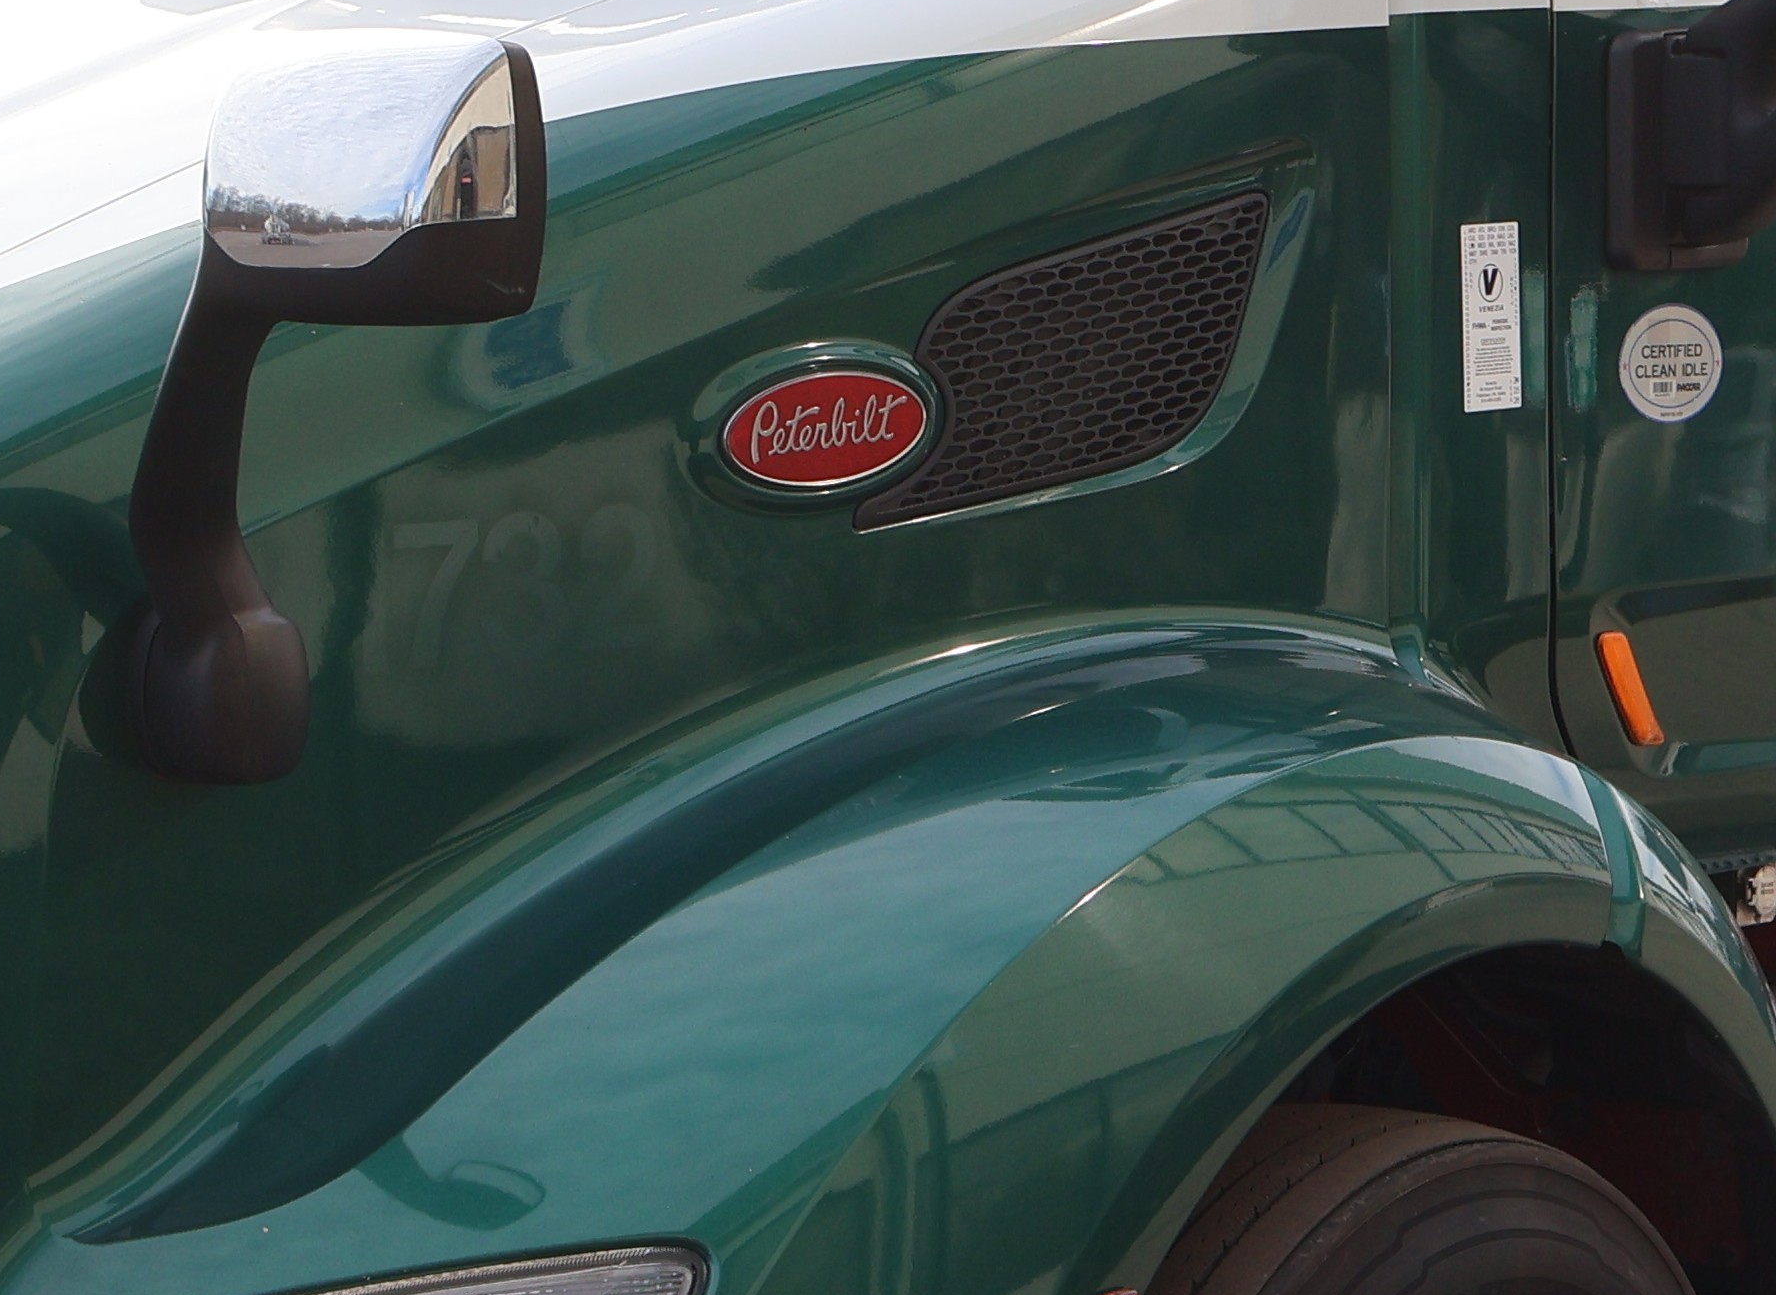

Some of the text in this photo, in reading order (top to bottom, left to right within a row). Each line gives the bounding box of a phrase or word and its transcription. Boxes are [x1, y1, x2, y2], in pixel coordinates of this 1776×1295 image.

[1483, 268, 1499, 296] V
[1479, 304, 1504, 313] VENEZIA
[1641, 343, 1703, 359] CERTIFIED
[1635, 362, 1708, 378] CLEAN IDLE
[750, 393, 908, 465] Peterbilt
